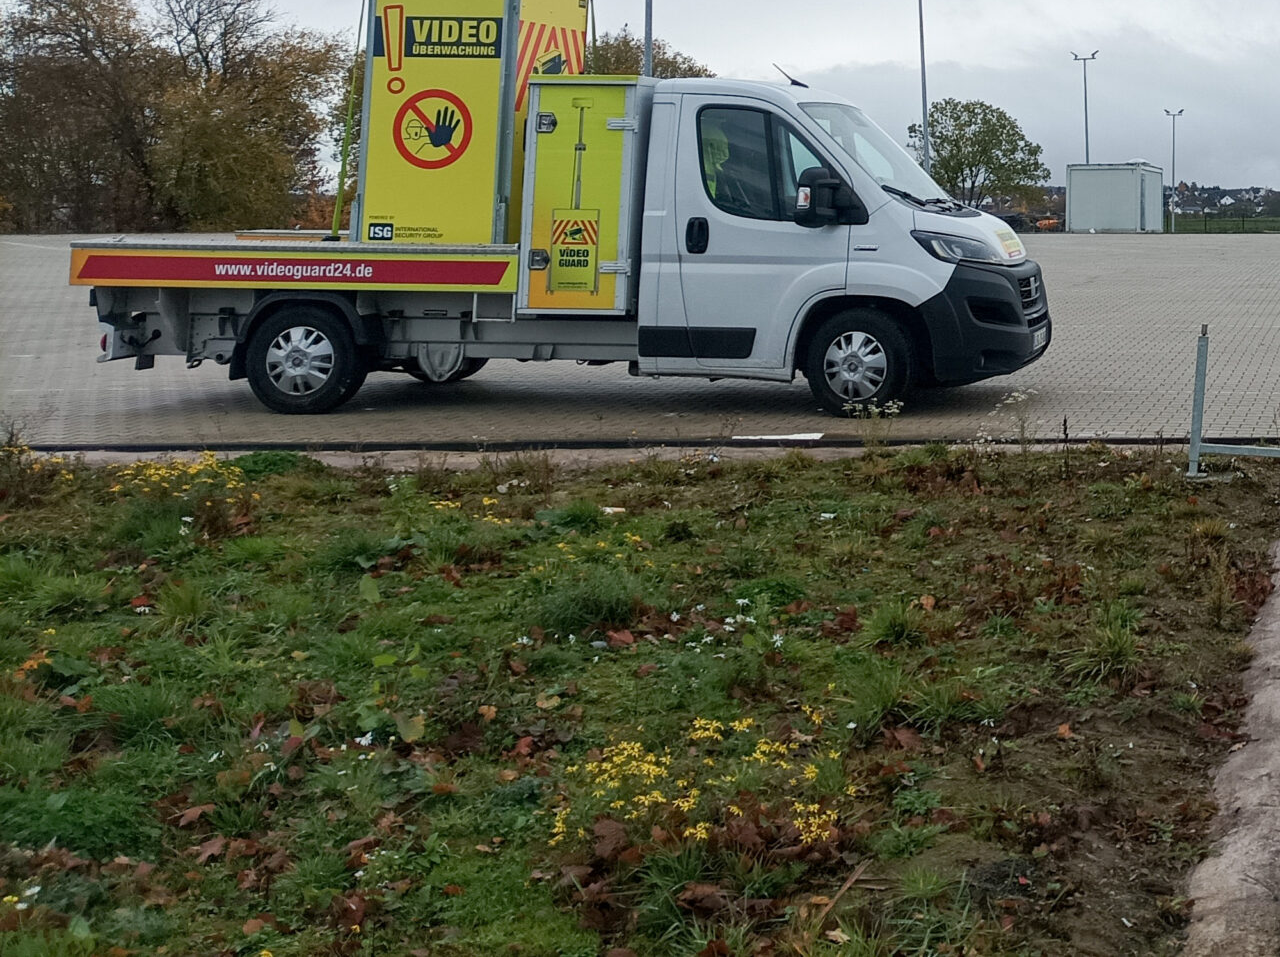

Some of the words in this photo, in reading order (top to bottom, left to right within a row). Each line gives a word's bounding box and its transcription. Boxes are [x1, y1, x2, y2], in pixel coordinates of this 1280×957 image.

[412, 19, 498, 44] VIDEO
[412, 43, 496, 56] ÜBERWACHUNG
[369, 226, 392, 238] ISG
[559, 259, 588, 267] GUARD
[214, 261, 373, 280] www.videoguard24.de
